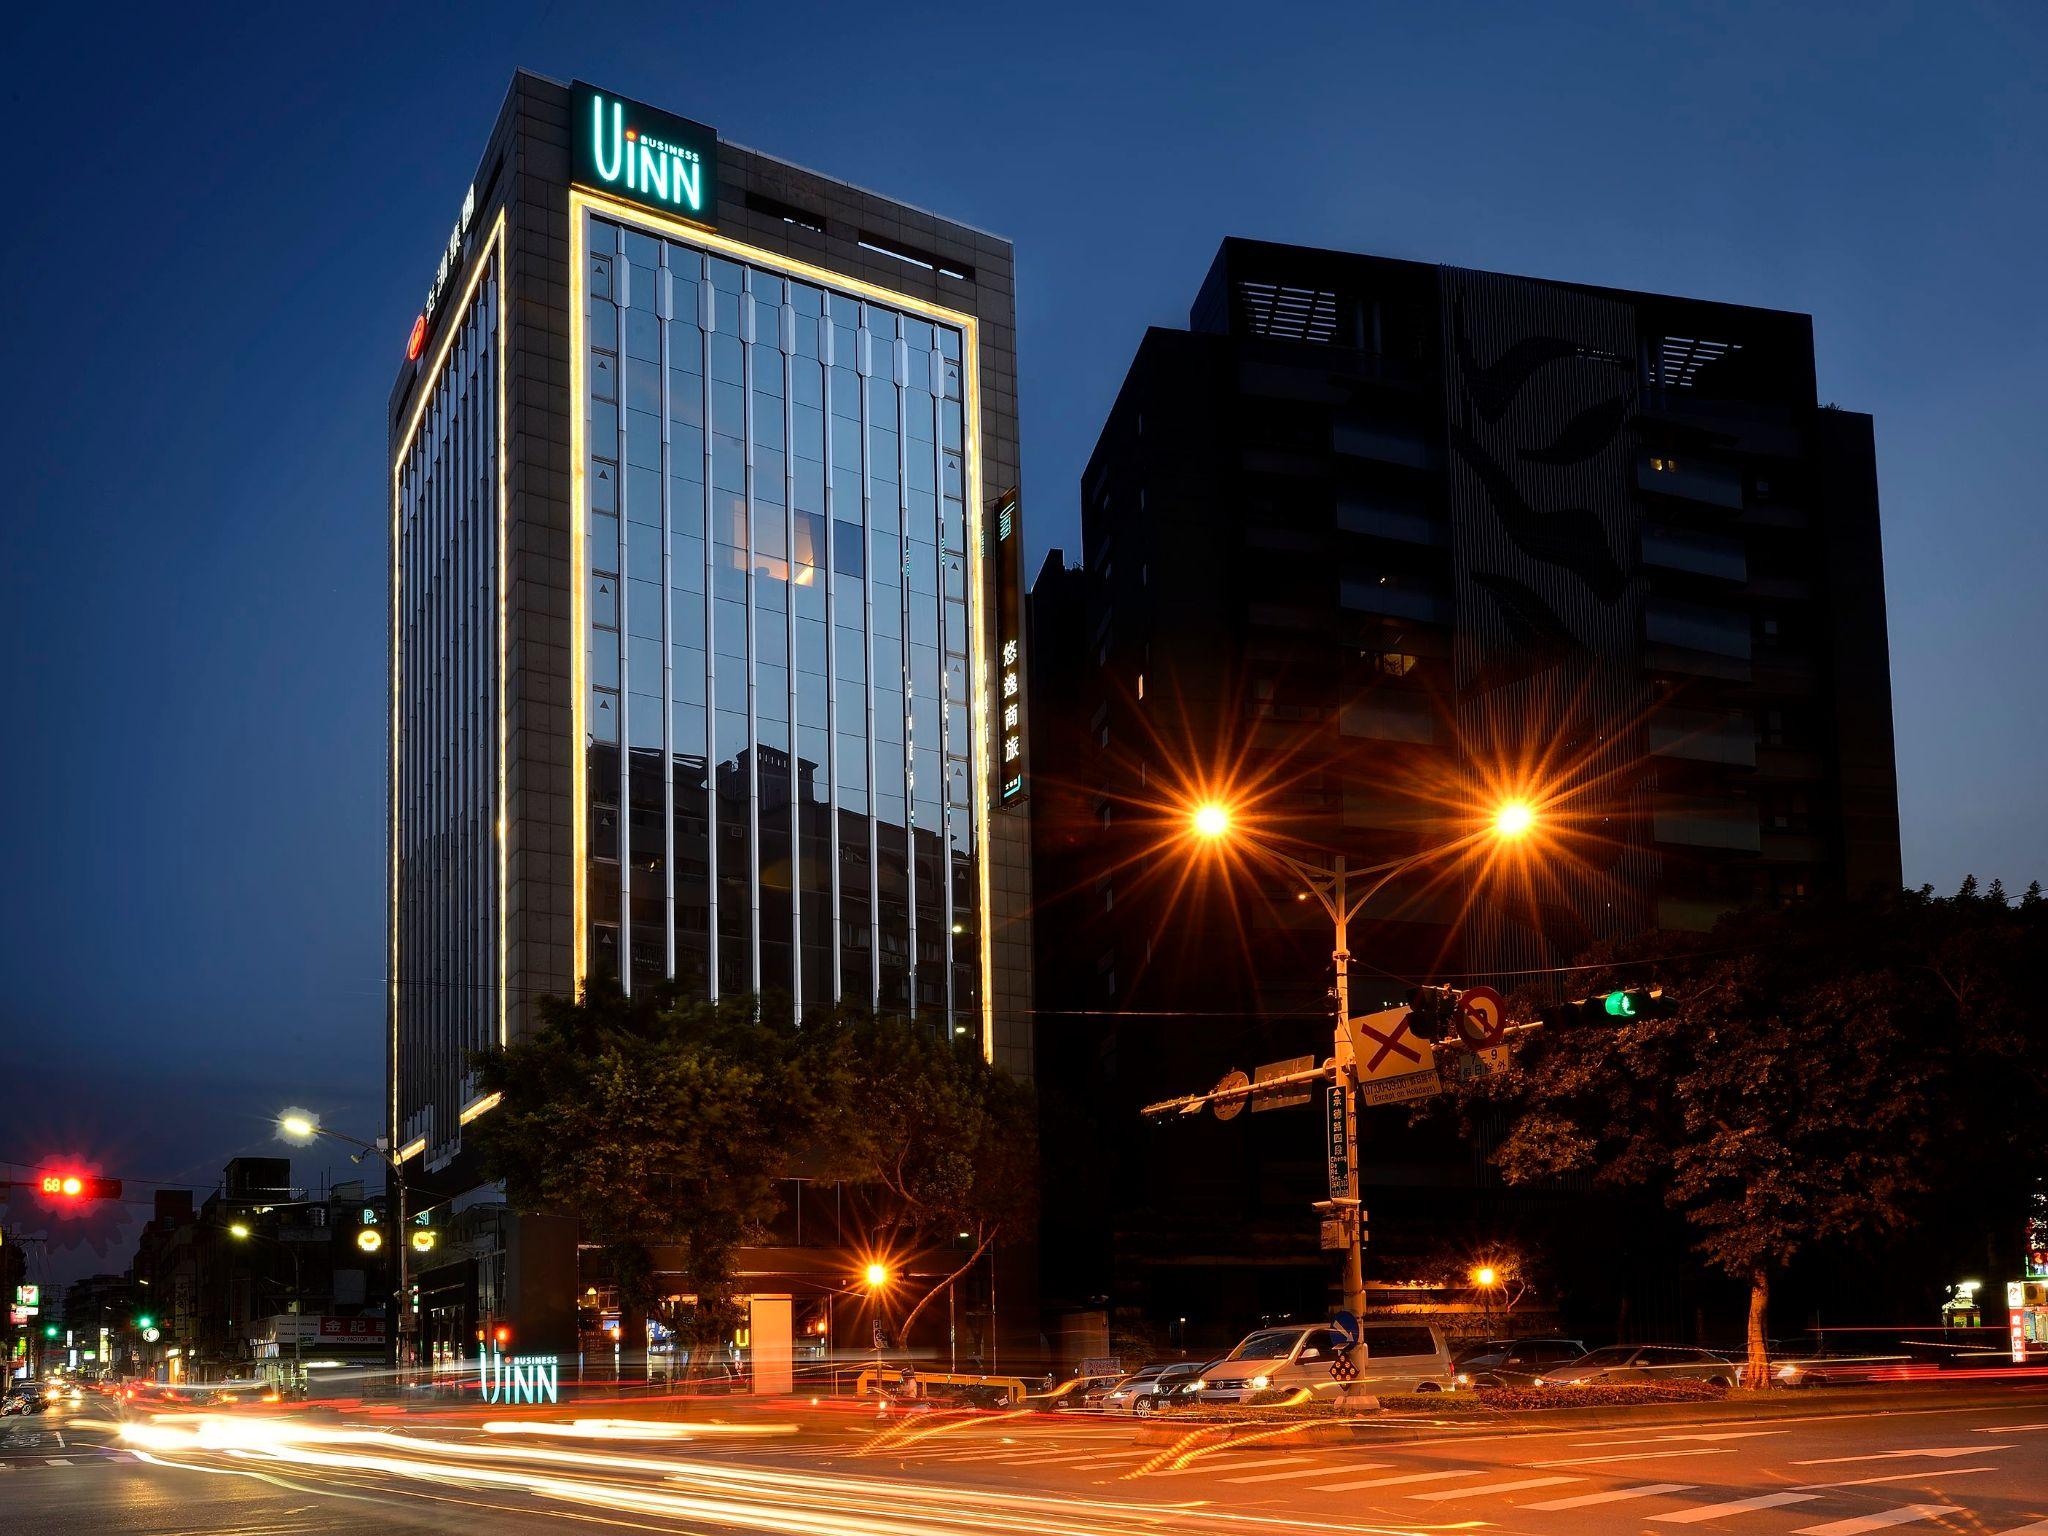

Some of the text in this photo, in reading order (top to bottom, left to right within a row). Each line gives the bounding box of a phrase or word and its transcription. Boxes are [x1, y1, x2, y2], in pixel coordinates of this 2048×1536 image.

[639, 134, 700, 163] BUSINESS
[1002, 638, 1020, 764] 悠逸商旅
[1397, 1090, 1406, 1098] on
[1330, 1156, 1347, 1164] Cheng
[364, 1209, 374, 1224] P
[513, 1356, 558, 1365] BUSINESS
